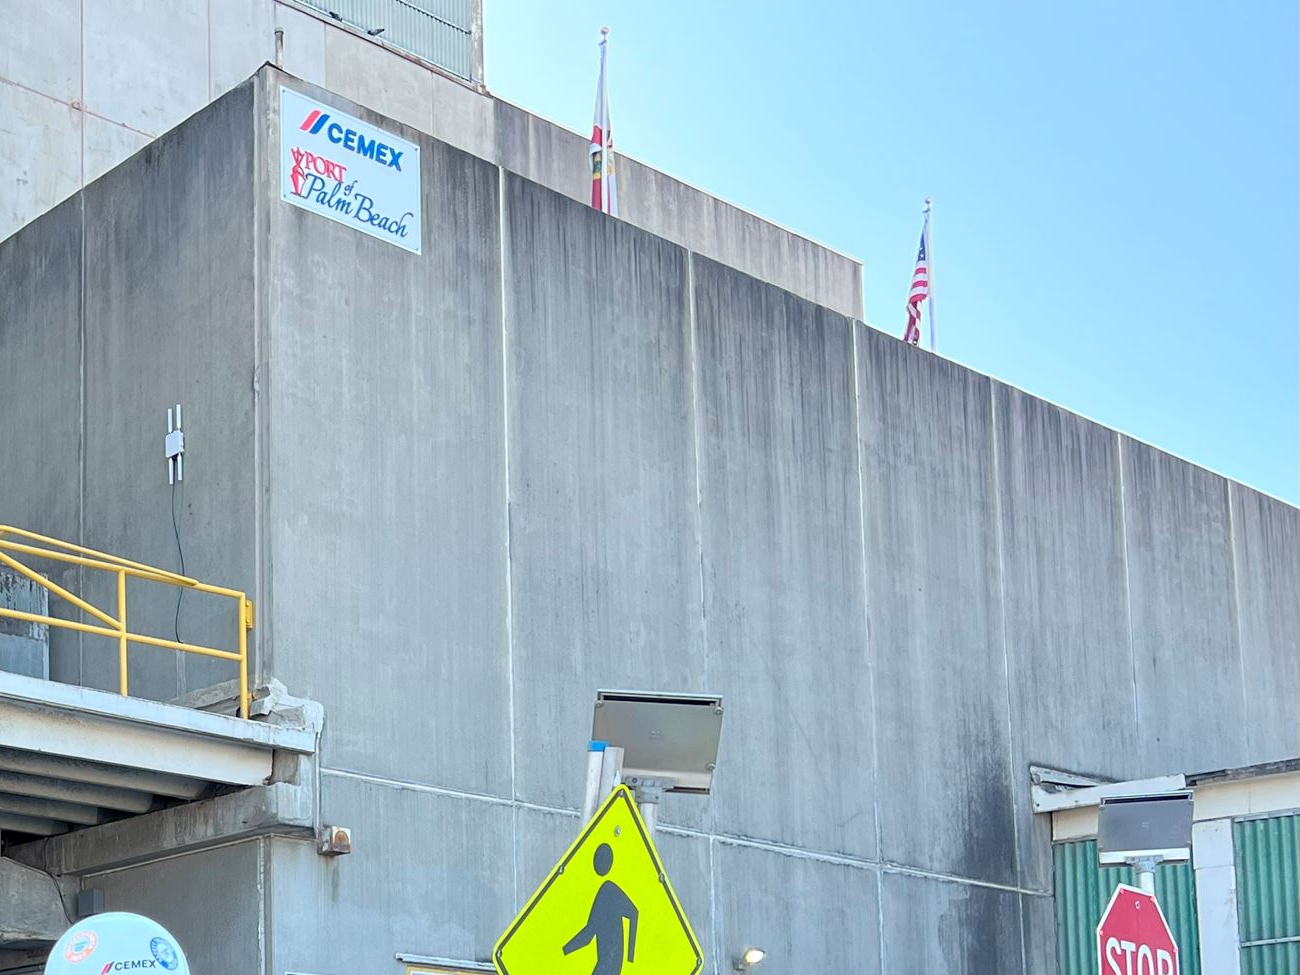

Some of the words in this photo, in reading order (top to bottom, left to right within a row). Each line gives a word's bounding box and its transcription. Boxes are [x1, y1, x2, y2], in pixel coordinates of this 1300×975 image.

[328, 122, 403, 172] CEMEX
[304, 151, 347, 182] PORT
[344, 179, 358, 195] of
[302, 173, 353, 215] Palm
[355, 193, 414, 238] Beach
[115, 960, 156, 971] CEMEX
